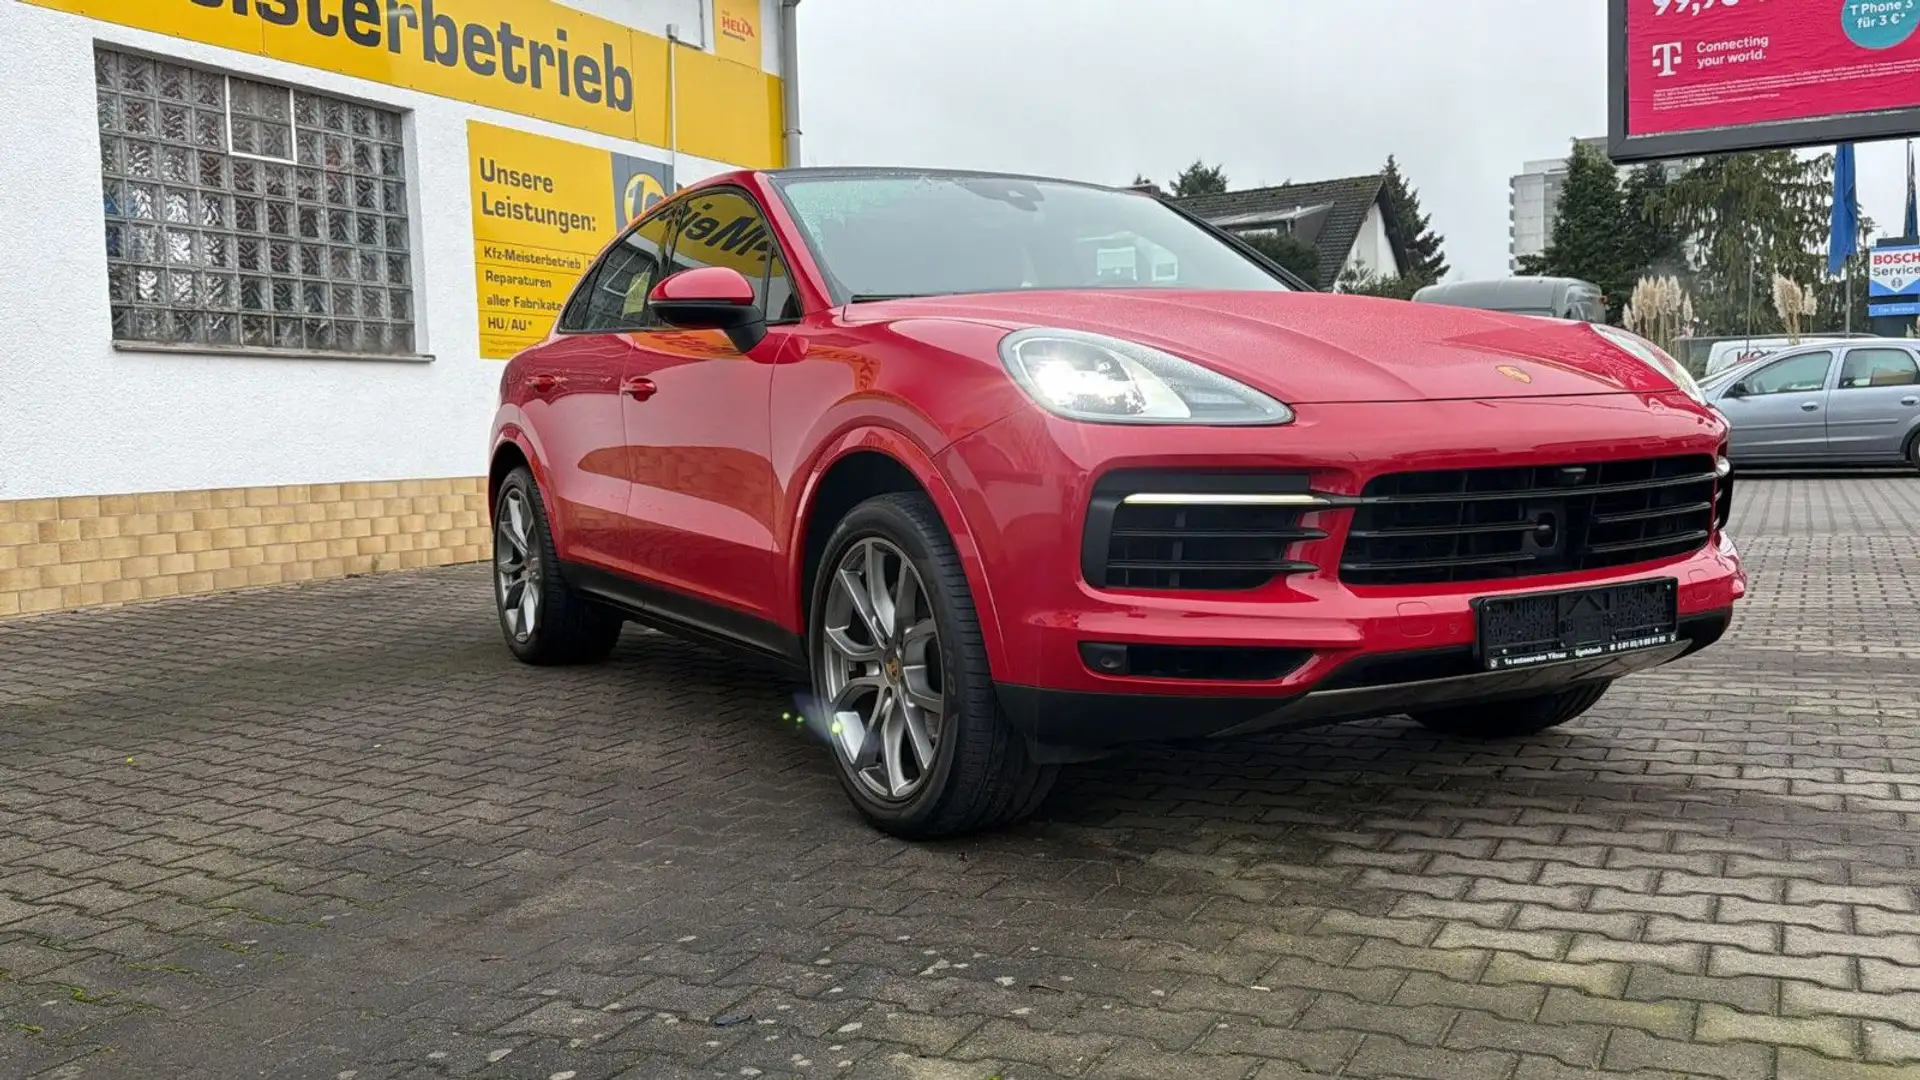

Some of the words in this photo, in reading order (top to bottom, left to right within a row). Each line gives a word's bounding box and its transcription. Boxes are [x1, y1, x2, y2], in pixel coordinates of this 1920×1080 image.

[1850, 4, 1859, 16] T
[1861, 1, 1902, 15] Phone
[722, 16, 755, 38] HELIX
[1857, 16, 1876, 29] für
[1879, 15, 1887, 26] 3
[1696, 36, 1769, 53] Connecting
[1697, 56, 1725, 69] your
[1727, 48, 1767, 63] world.
[479, 157, 554, 193] Unsere
[481, 191, 597, 234] Leistungen:
[484, 245, 581, 270] Kfz-Meisterbetrieb
[1873, 252, 1920, 265] BOSCH
[485, 269, 552, 288] Reparaturen
[1872, 265, 1920, 277] Service
[486, 293, 511, 307] aller
